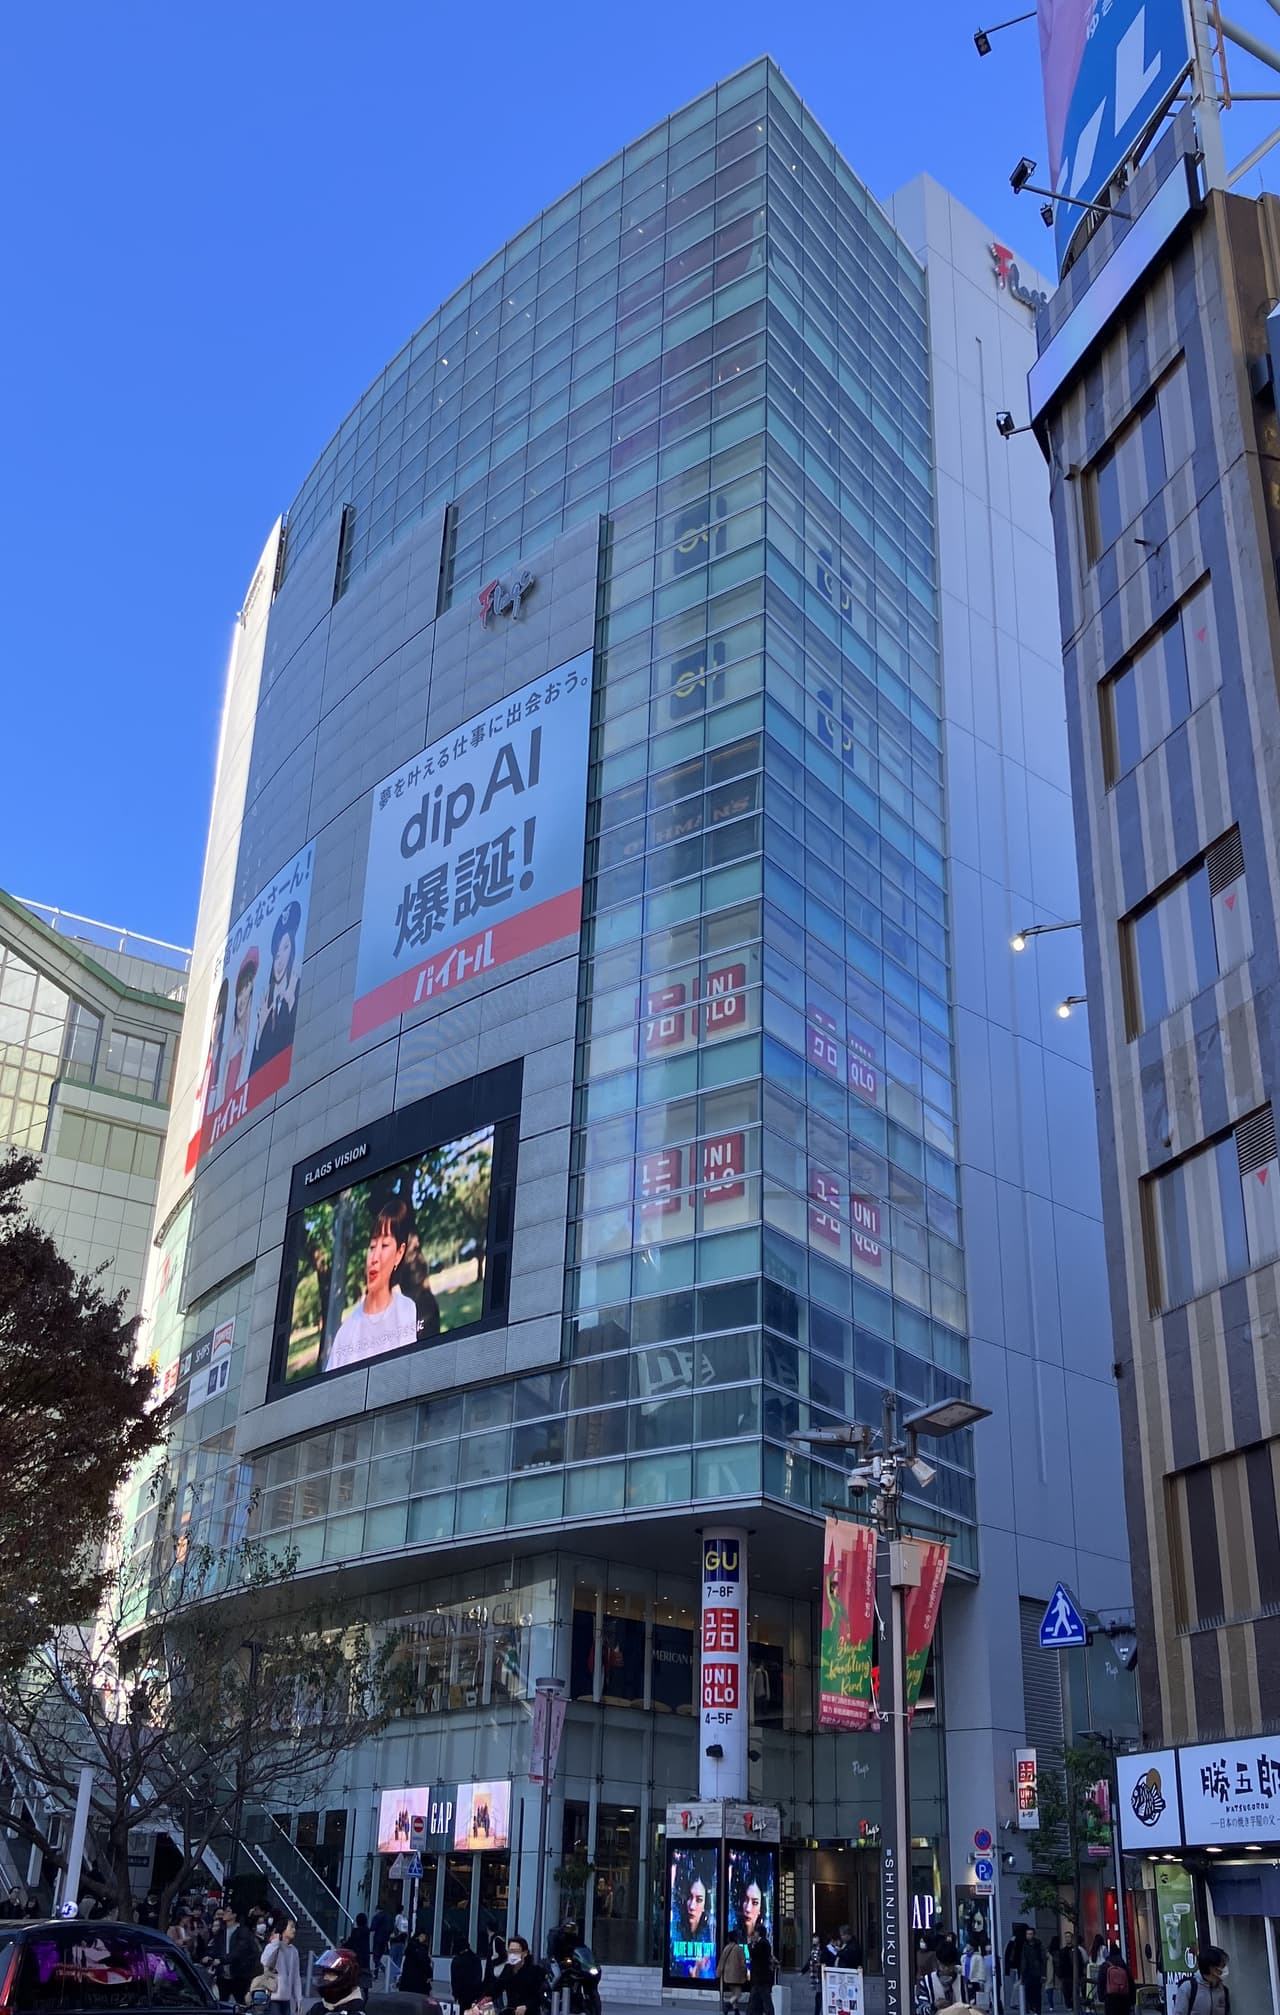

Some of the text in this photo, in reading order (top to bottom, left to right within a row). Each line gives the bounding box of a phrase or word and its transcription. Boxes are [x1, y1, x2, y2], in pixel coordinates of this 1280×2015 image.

[379, 671, 588, 811] 夢を叶える仕事に出会おう。
[400, 725, 542, 859] dip AI
[393, 816, 536, 959] 爆誕!
[413, 930, 495, 1003] バイトル
[851, 1063, 874, 1093] QLO
[210, 1082, 249, 1144] バイトル
[304, 1143, 367, 1186] FLAGS VISION
[854, 1201, 876, 1233] UNI
[705, 1550, 738, 1571] GU
[706, 1585, 734, 1598] 7-8F
[704, 1668, 732, 1684] UNI
[704, 1687, 735, 1705] QLO
[704, 1712, 733, 1725] 4-5F
[430, 1802, 453, 1835] GAP
[884, 1858, 896, 1966] SHINJUKU
[912, 1894, 934, 1929] AP
